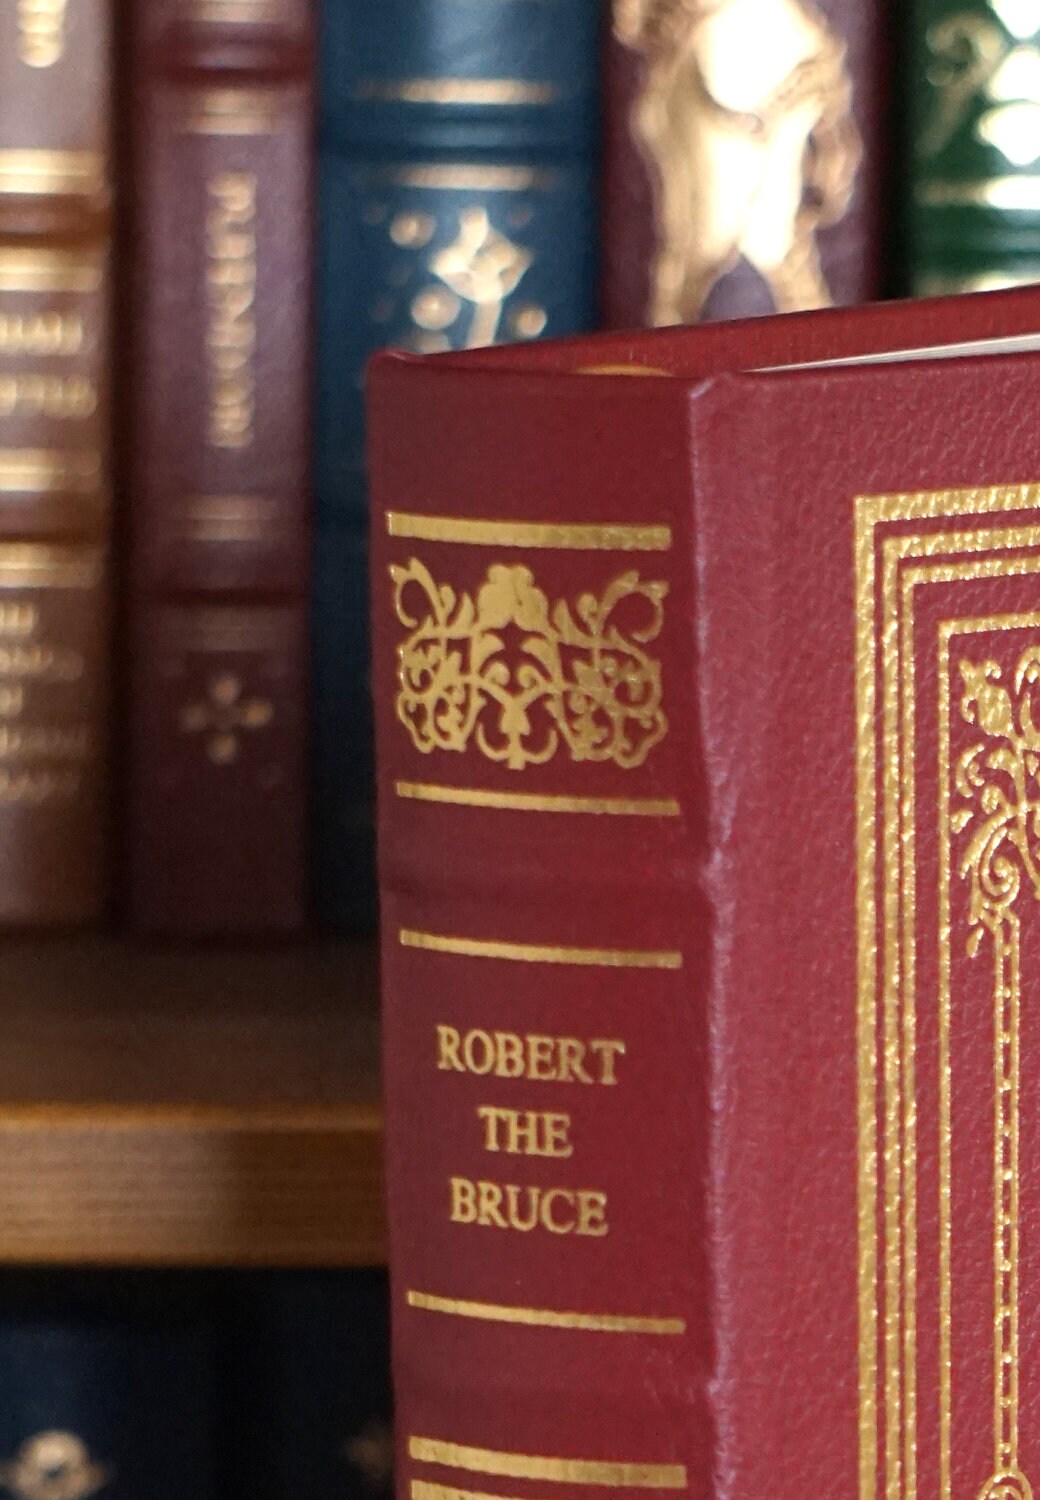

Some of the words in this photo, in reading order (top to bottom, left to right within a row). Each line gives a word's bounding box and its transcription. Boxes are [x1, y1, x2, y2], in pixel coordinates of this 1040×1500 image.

[437, 1024, 626, 1086] ROBERT
[478, 1105, 574, 1158] THE
[450, 1177, 608, 1236] BRUCE
